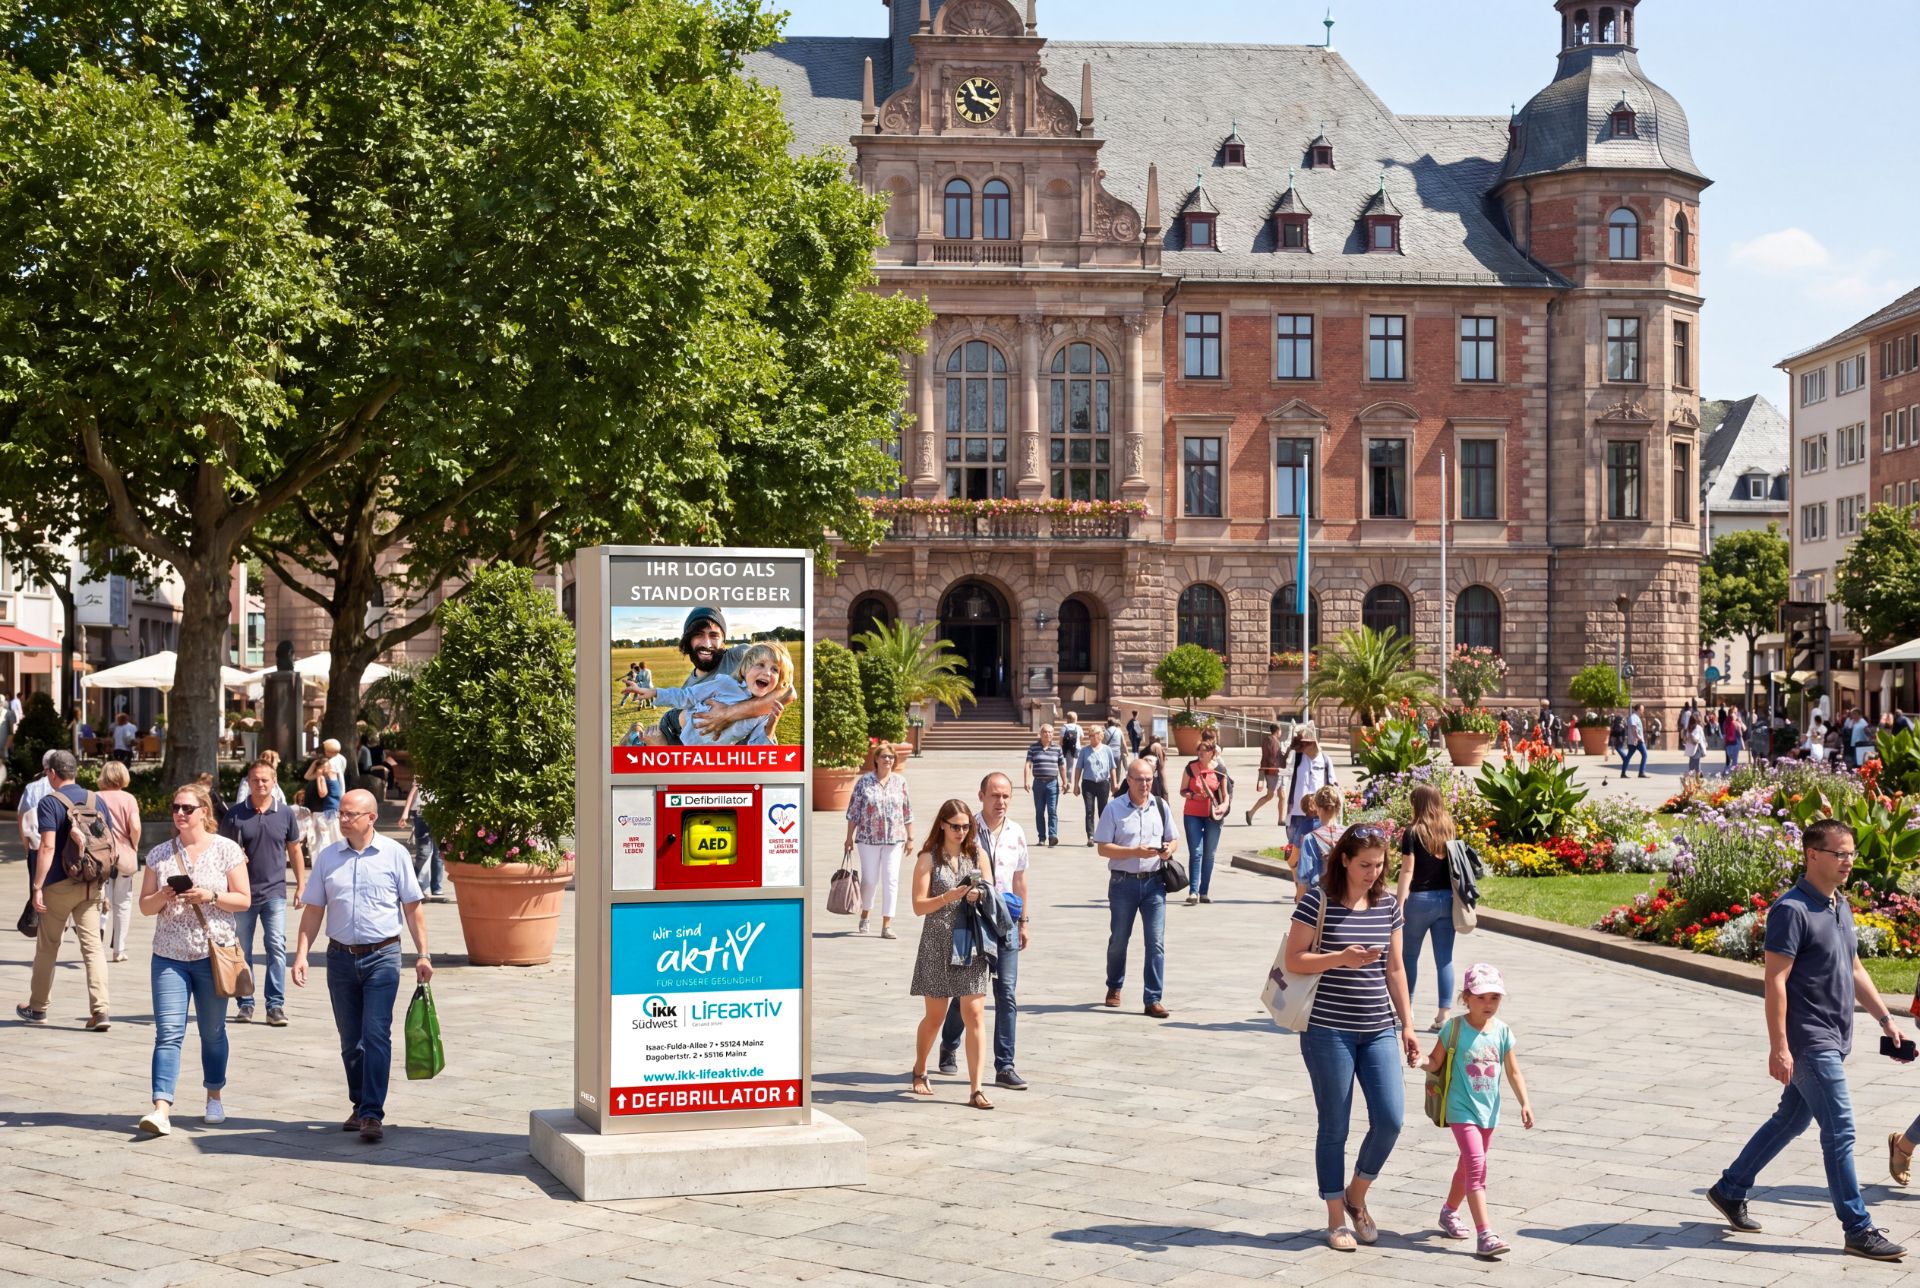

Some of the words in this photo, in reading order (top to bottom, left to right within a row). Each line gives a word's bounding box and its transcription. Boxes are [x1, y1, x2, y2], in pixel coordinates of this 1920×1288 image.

[647, 561, 679, 576] IHR
[685, 562, 737, 577] LOGO
[742, 563, 776, 577] ALS
[630, 586, 791, 601] STANDORTGEBER
[641, 751, 778, 766] NOTFALLHILFE
[685, 795, 748, 805] Defibrillator
[697, 838, 728, 851] AED
[676, 922, 702, 938] sind
[676, 977, 709, 987] UNSERE
[711, 975, 763, 986] GESUNDHEIT
[632, 1018, 678, 1030] Südwest
[645, 1042, 708, 1051] Isaac-Fulda-Allee
[720, 1040, 741, 1048] 55124
[742, 1039, 764, 1047] Mainz
[645, 1053, 692, 1062] Dagobertstr.
[704, 1051, 724, 1059] 55116
[725, 1050, 747, 1058] Mainz
[643, 1066, 765, 1082] www.ikk-lifeaktiv.de
[632, 1087, 781, 1109] DEFIBRILLATOR
